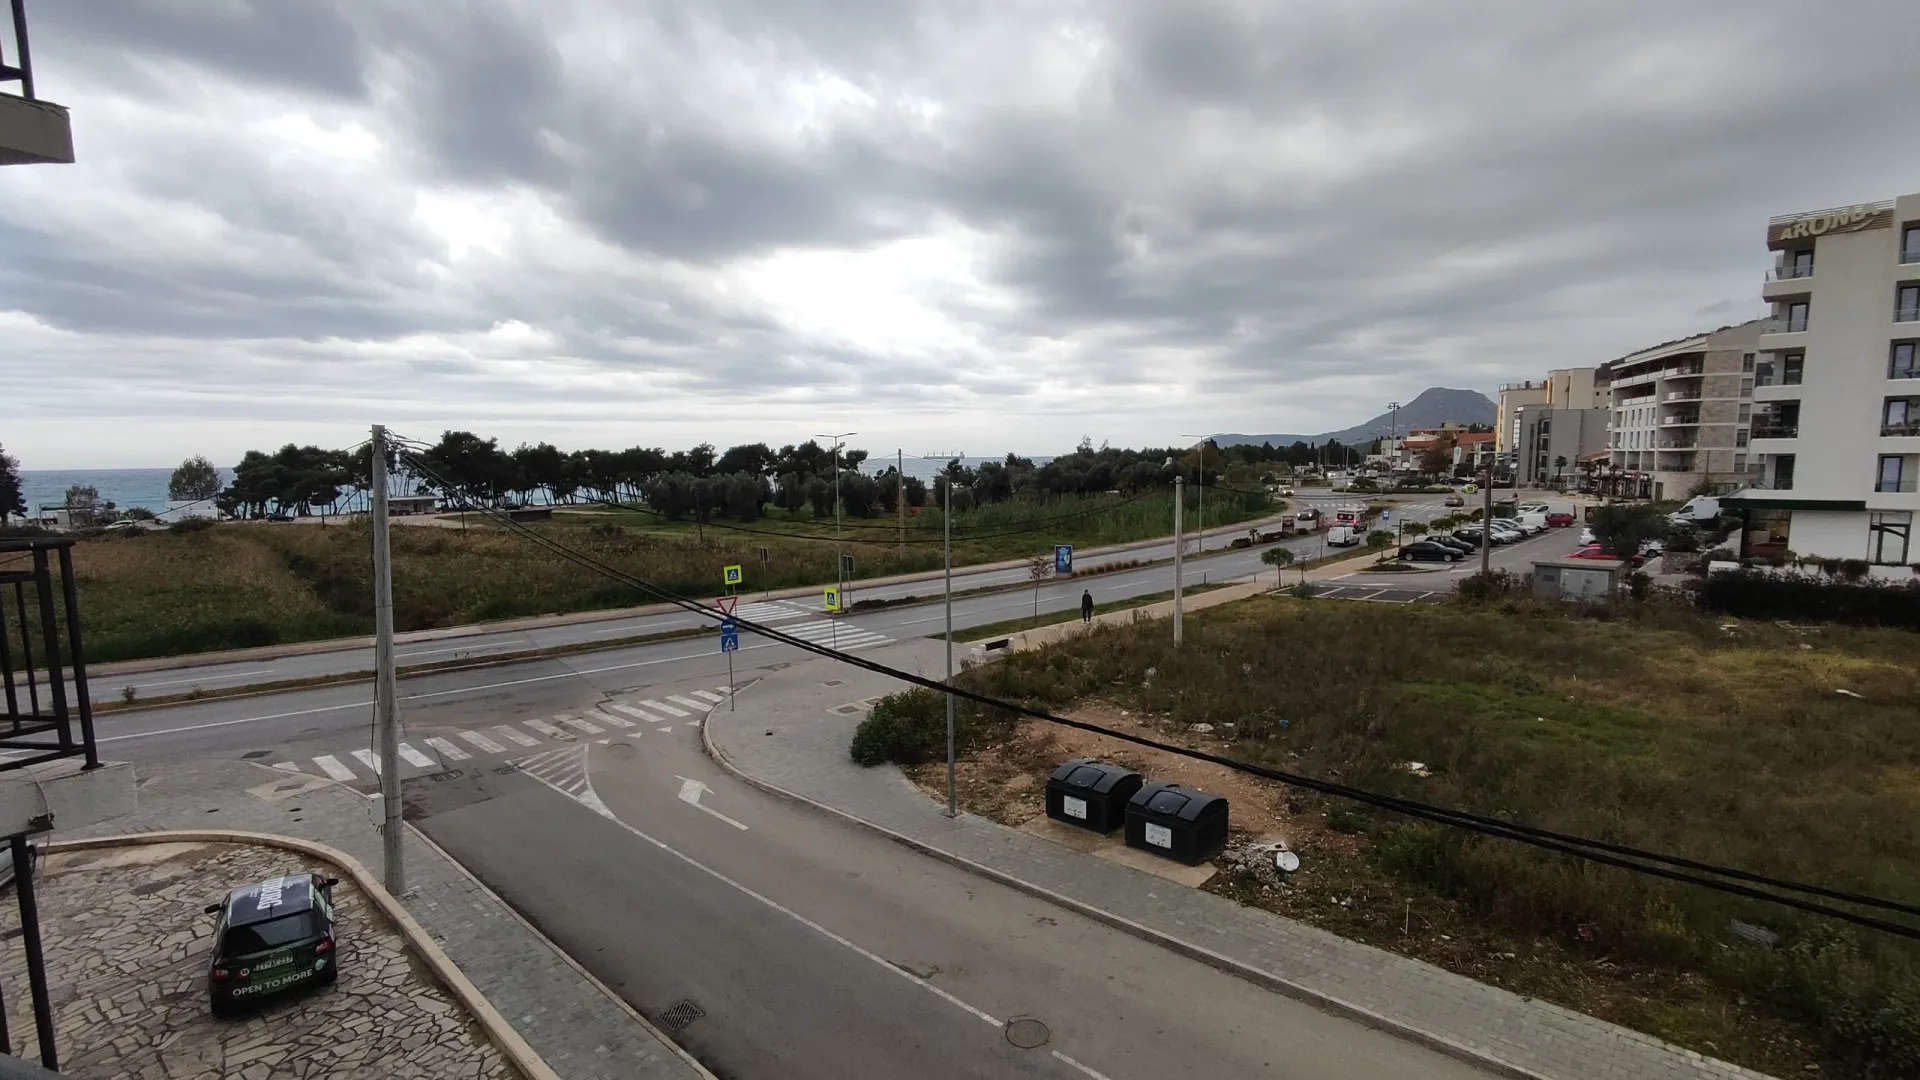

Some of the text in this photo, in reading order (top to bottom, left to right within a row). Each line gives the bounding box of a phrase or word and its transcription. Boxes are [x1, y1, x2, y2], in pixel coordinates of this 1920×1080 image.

[233, 969, 313, 996] OPEN TO MORE
